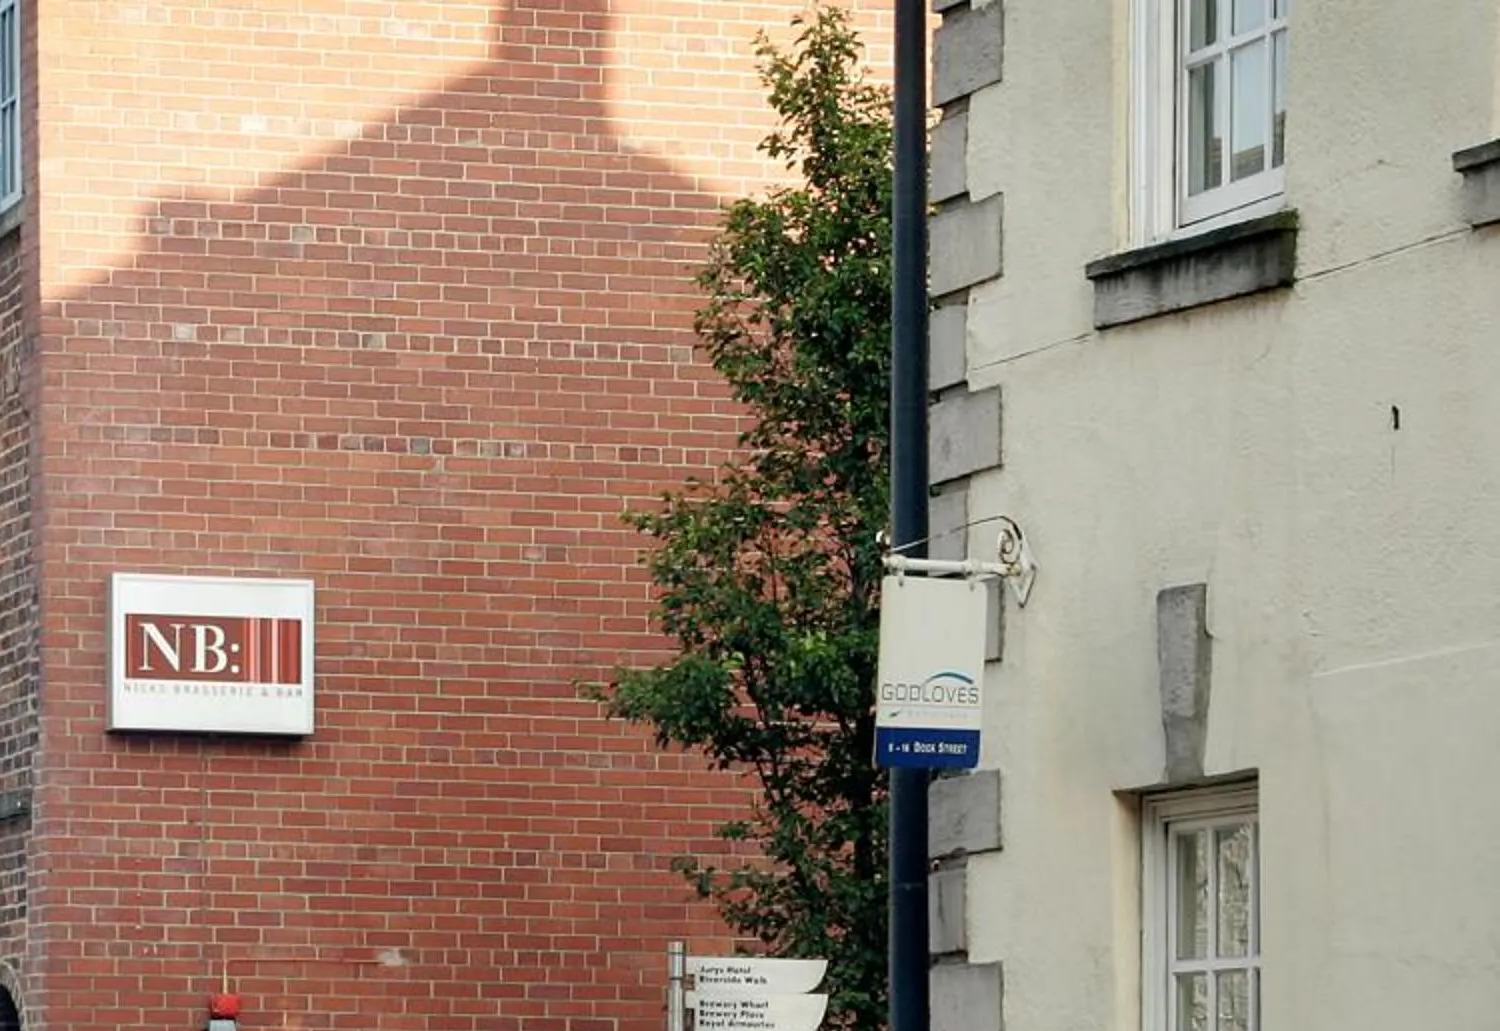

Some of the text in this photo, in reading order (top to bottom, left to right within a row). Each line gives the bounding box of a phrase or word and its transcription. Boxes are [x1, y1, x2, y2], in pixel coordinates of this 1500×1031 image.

[137, 621, 240, 675] NB:
[881, 683, 980, 704] GODLOVES
[699, 1000, 769, 1010] Brewery Wharf
[699, 1009, 737, 1019] Brewery
[699, 1019, 725, 1029] Royal
